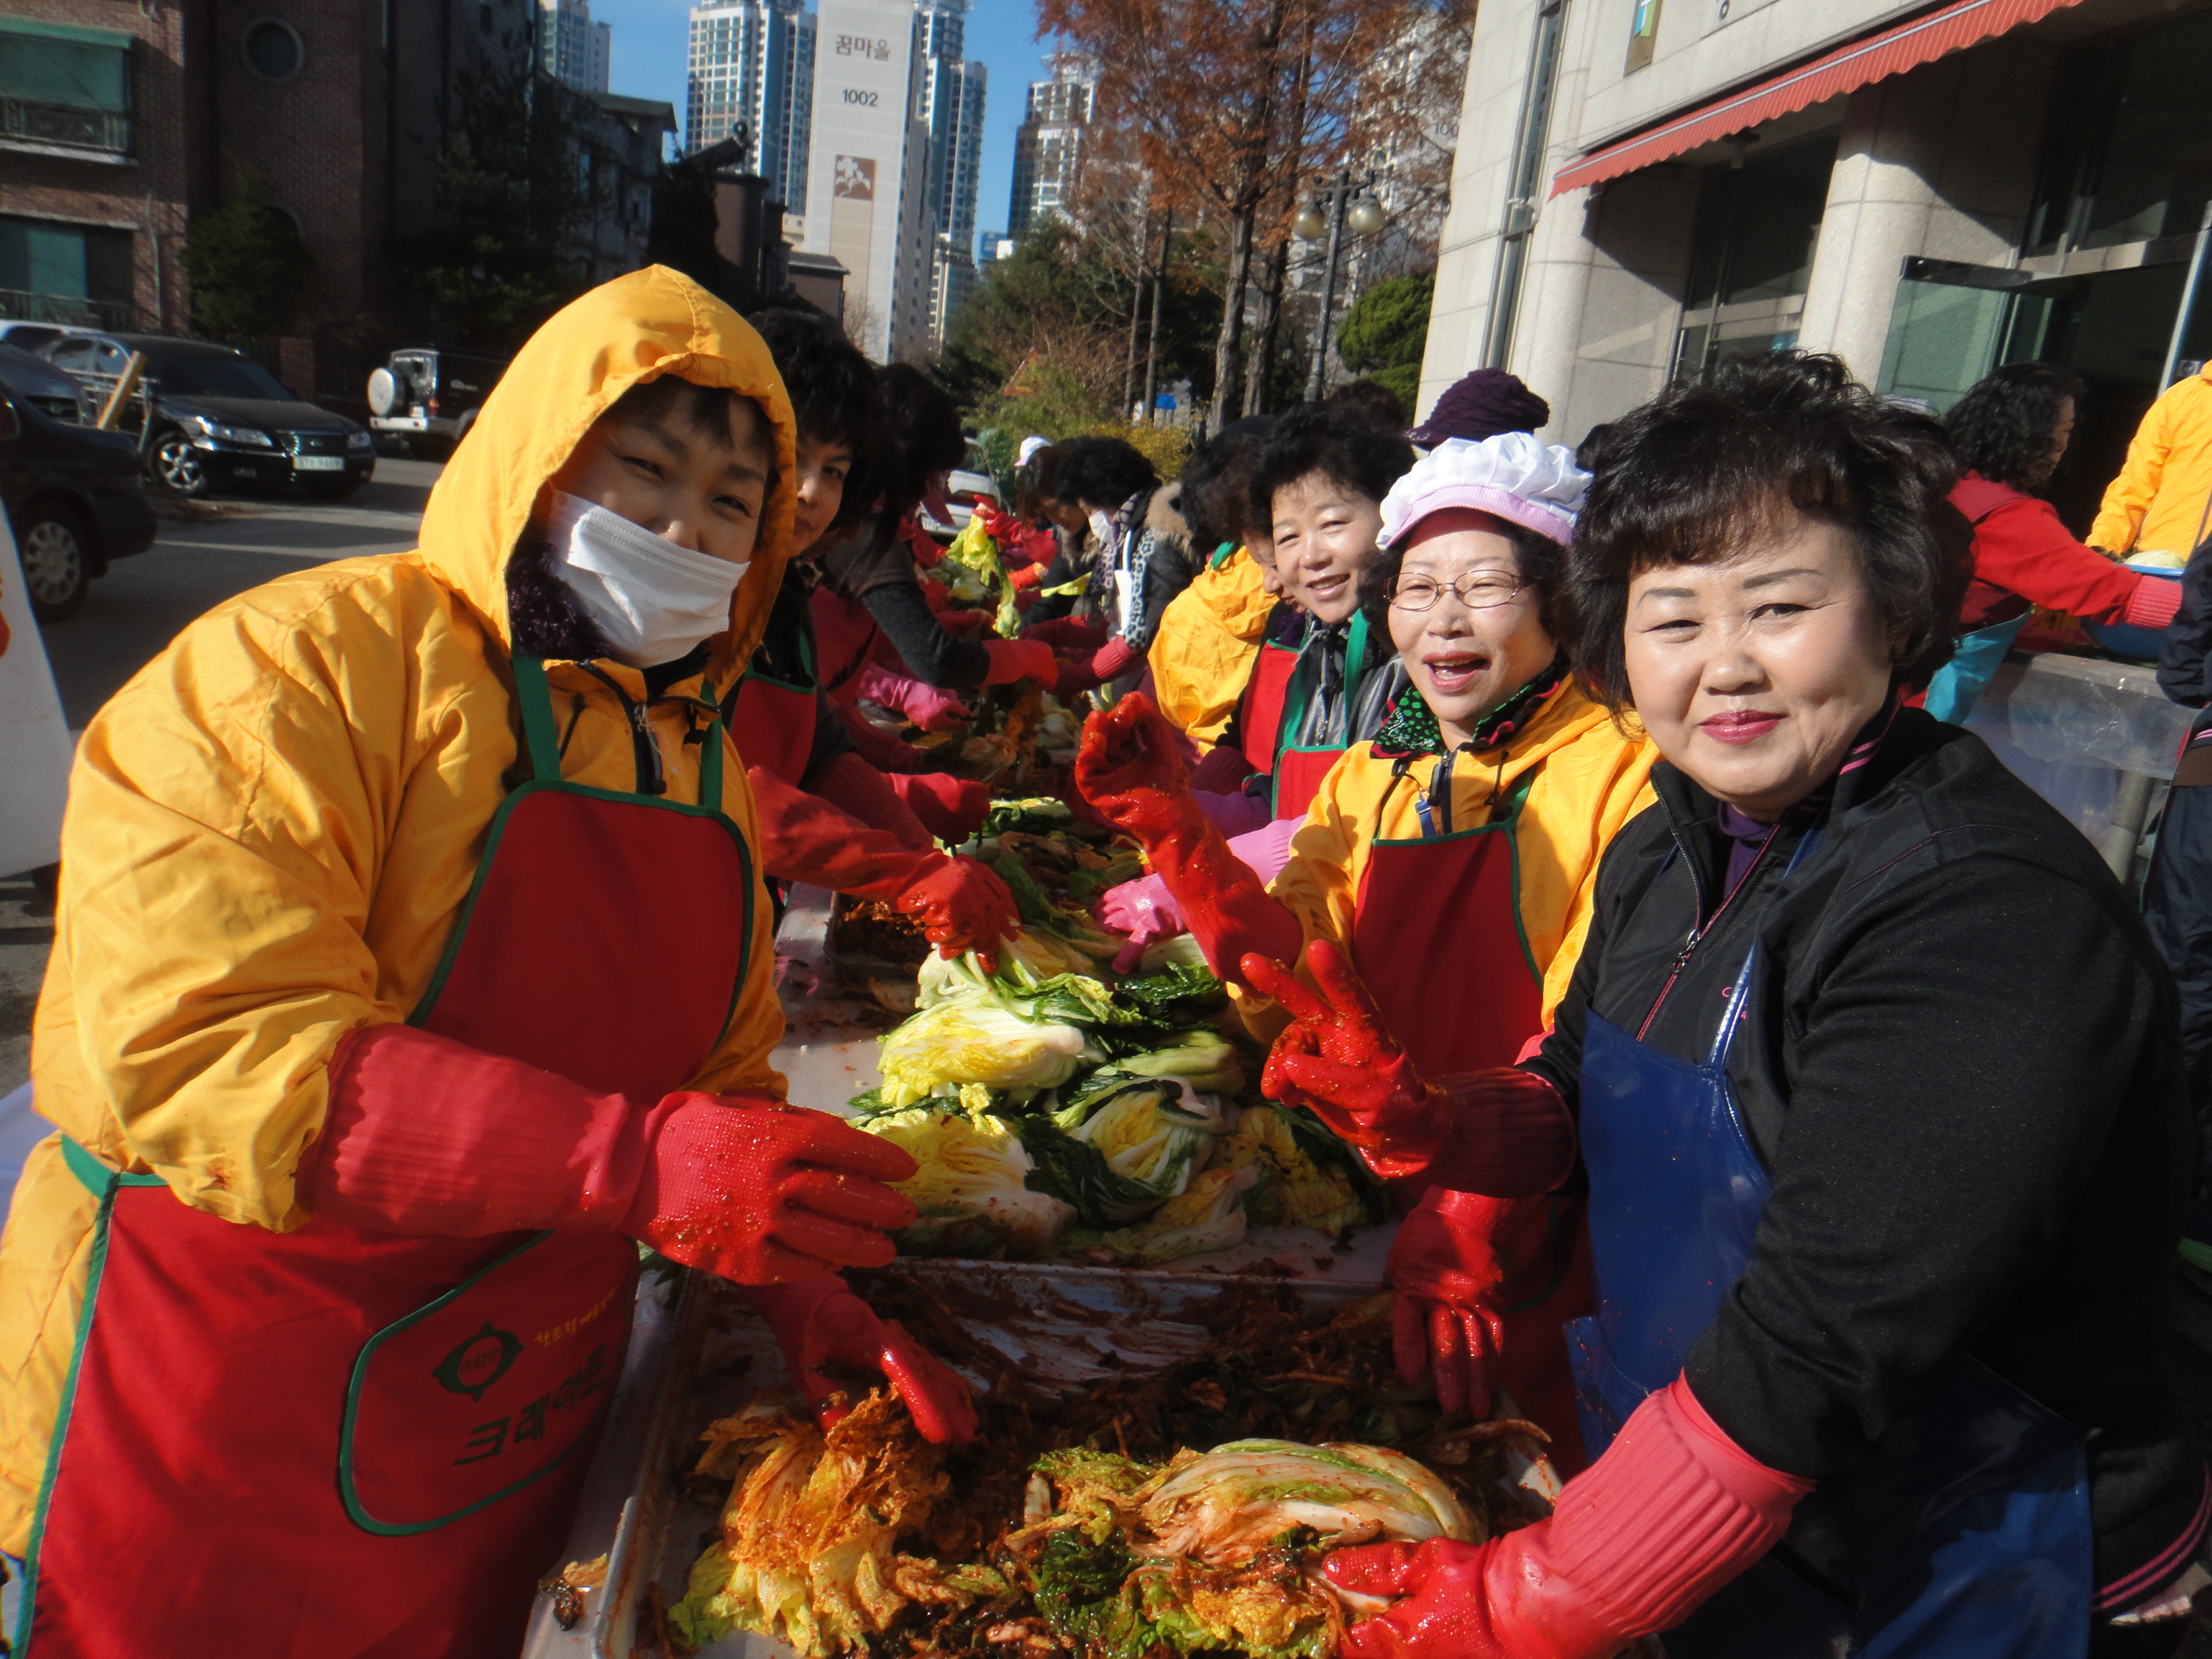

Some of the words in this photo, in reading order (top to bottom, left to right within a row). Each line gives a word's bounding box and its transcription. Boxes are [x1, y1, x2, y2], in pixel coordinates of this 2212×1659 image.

[835, 34, 890, 61] 꿈마을
[842, 89, 878, 108] 1002
[458, 1347, 502, 1373] ART
